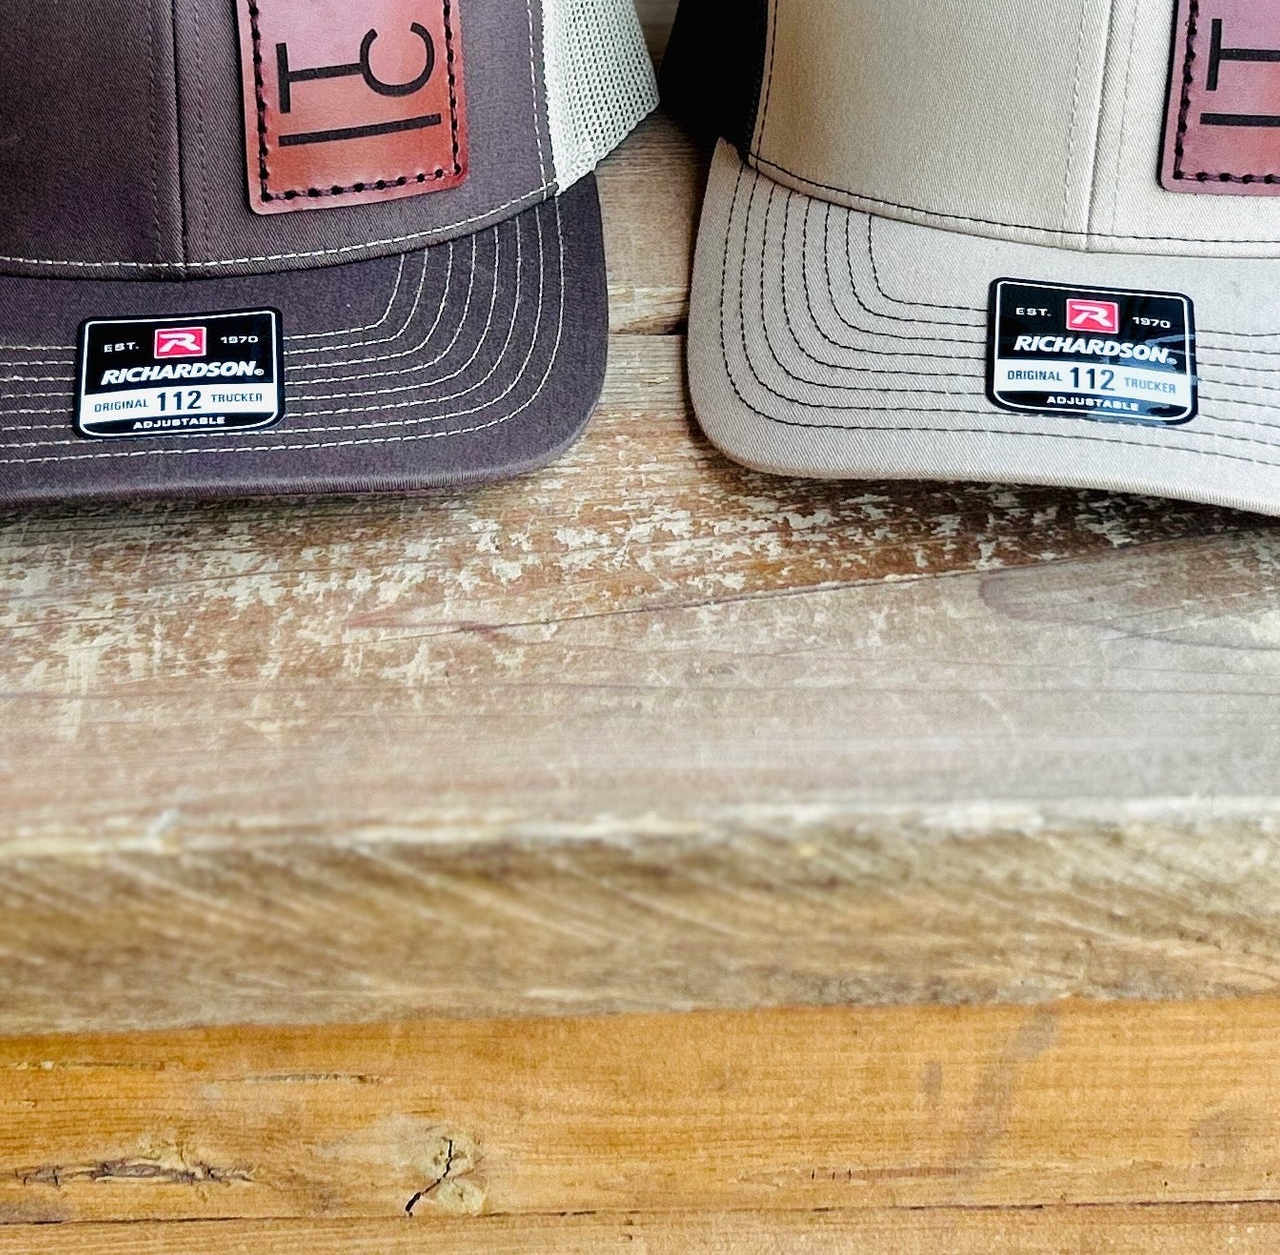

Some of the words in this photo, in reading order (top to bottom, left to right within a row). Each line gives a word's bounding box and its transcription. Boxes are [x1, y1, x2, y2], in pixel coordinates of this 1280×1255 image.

[1015, 307, 1051, 317] EST.
[1132, 316, 1171, 328] 1970
[104, 342, 139, 353] EST.
[220, 335, 259, 344] 1970
[1007, 370, 1062, 381] ORIGINAL
[1069, 367, 1116, 391] 112
[1124, 377, 1177, 394] TRUCKER
[94, 398, 149, 413] ORIGINAL
[156, 390, 202, 411] 112
[211, 393, 263, 403] TRUCKER
[1046, 396, 1139, 412] ADJUSTABLE
[133, 416, 225, 430] ADJUSTABLE
